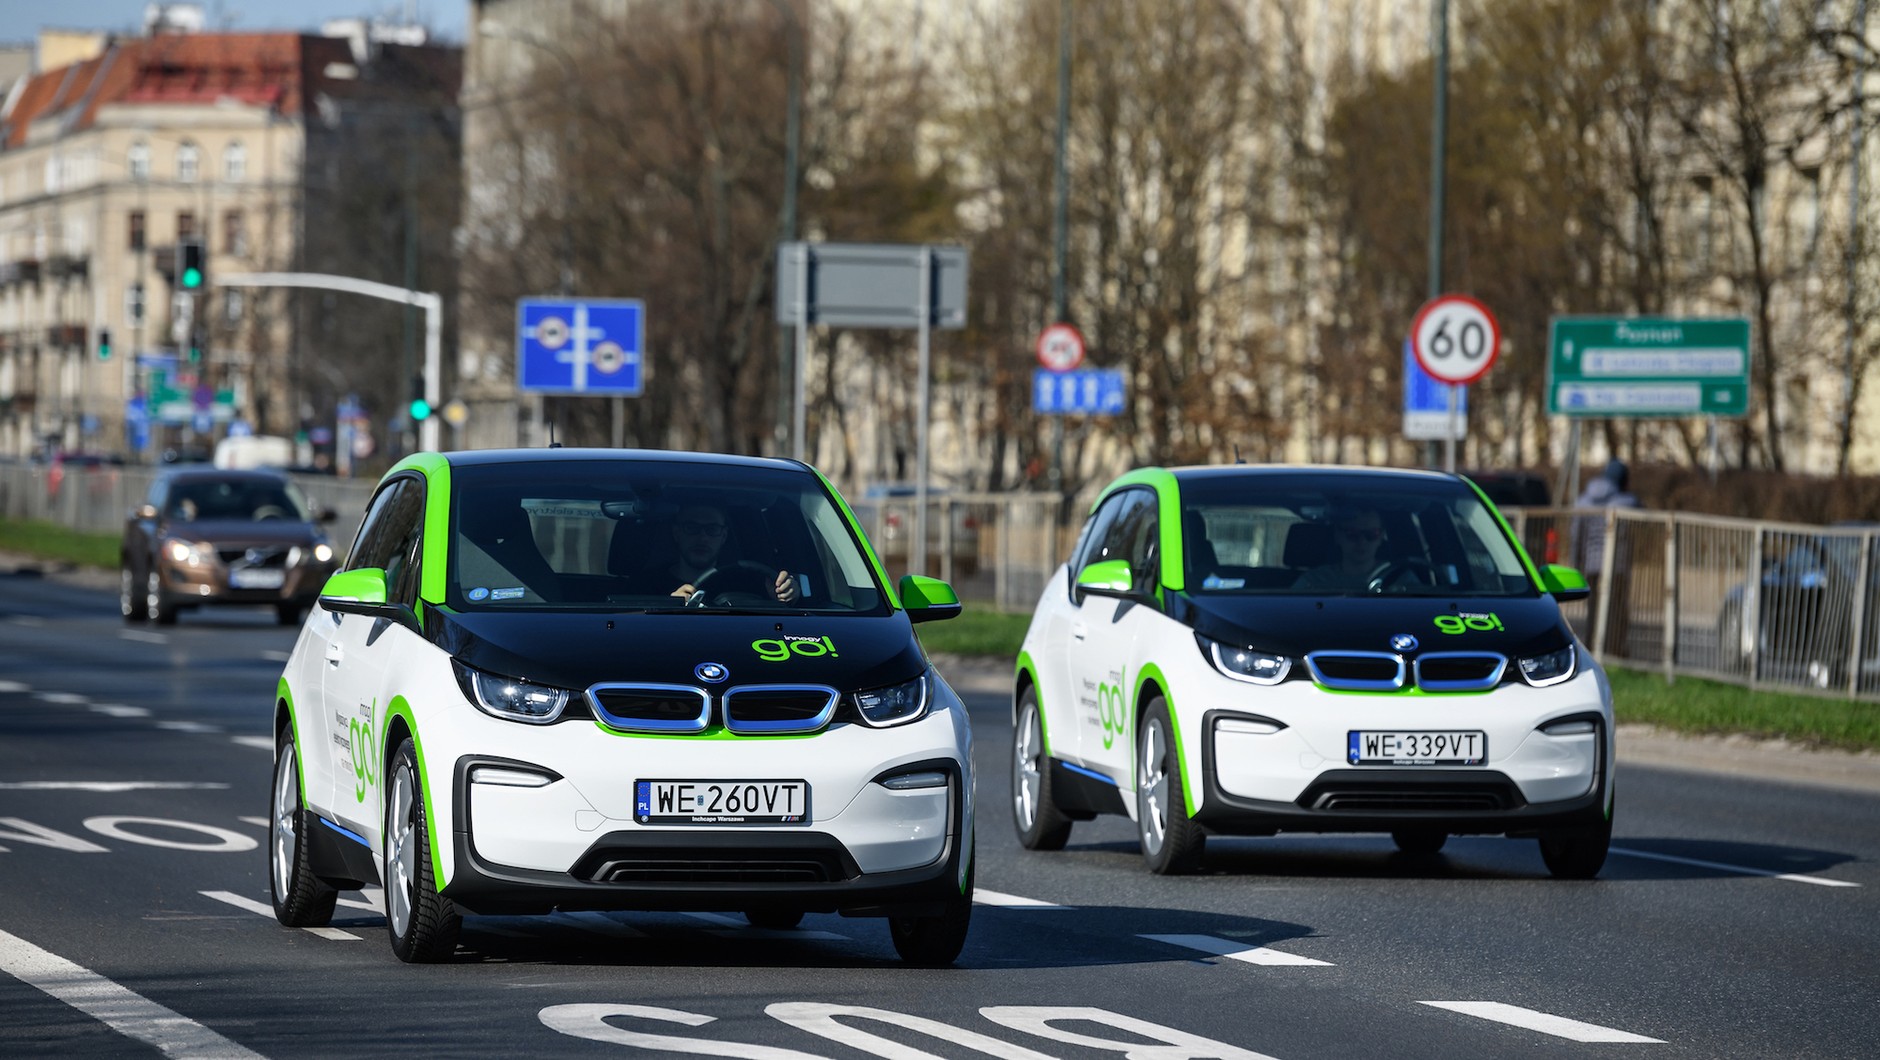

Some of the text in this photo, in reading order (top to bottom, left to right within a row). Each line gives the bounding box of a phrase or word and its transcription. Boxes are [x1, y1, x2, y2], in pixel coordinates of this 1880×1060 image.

[1429, 317, 1485, 360] 60
[1433, 612, 1505, 635] go!
[752, 635, 839, 662] go!
[1366, 734, 1477, 757] WE 339VT
[638, 802, 649, 811] PL
[657, 785, 798, 813] WE 260VT
